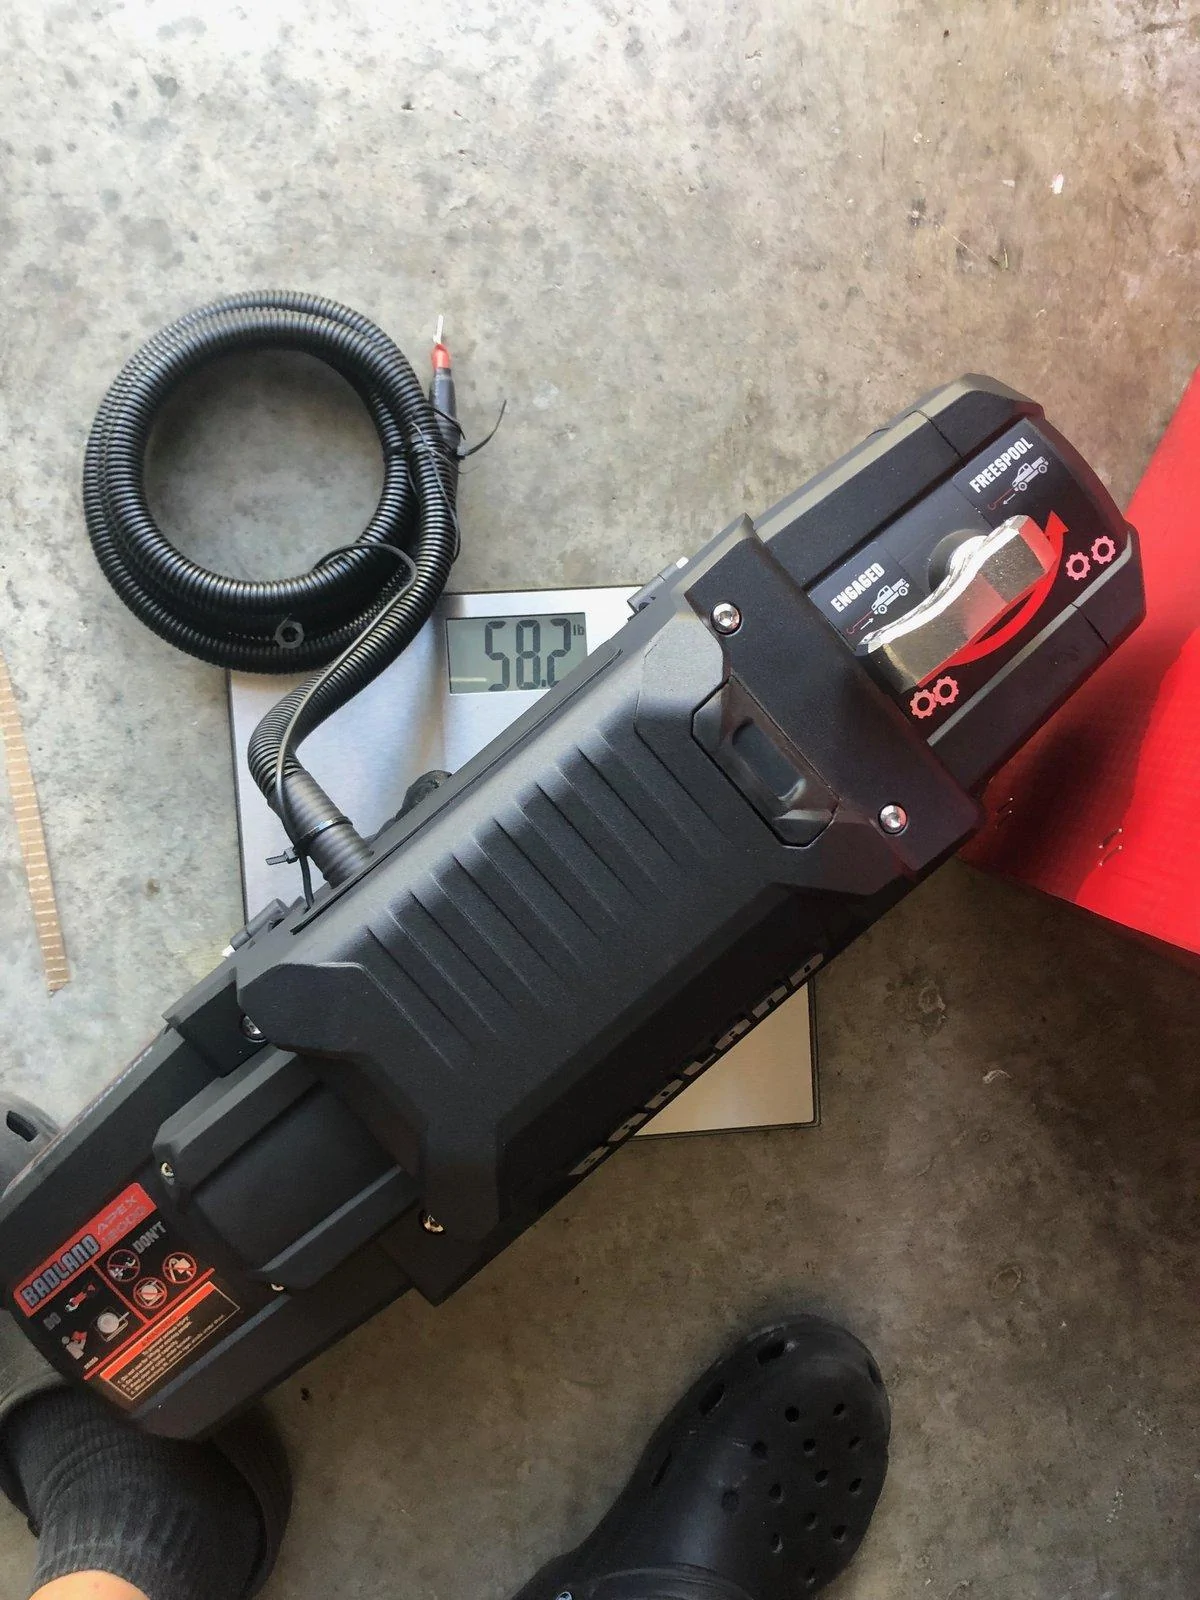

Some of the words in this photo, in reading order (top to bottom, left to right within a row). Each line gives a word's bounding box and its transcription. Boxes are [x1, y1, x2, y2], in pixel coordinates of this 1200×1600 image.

[969, 437, 1033, 494] FREESPOOL
[830, 562, 885, 613] ENGAGED
[485, 618, 571, 692] 58.2
[97, 1196, 137, 1235] APEX
[132, 1221, 167, 1254] DON'T
[21, 1234, 100, 1308] BADLAND
